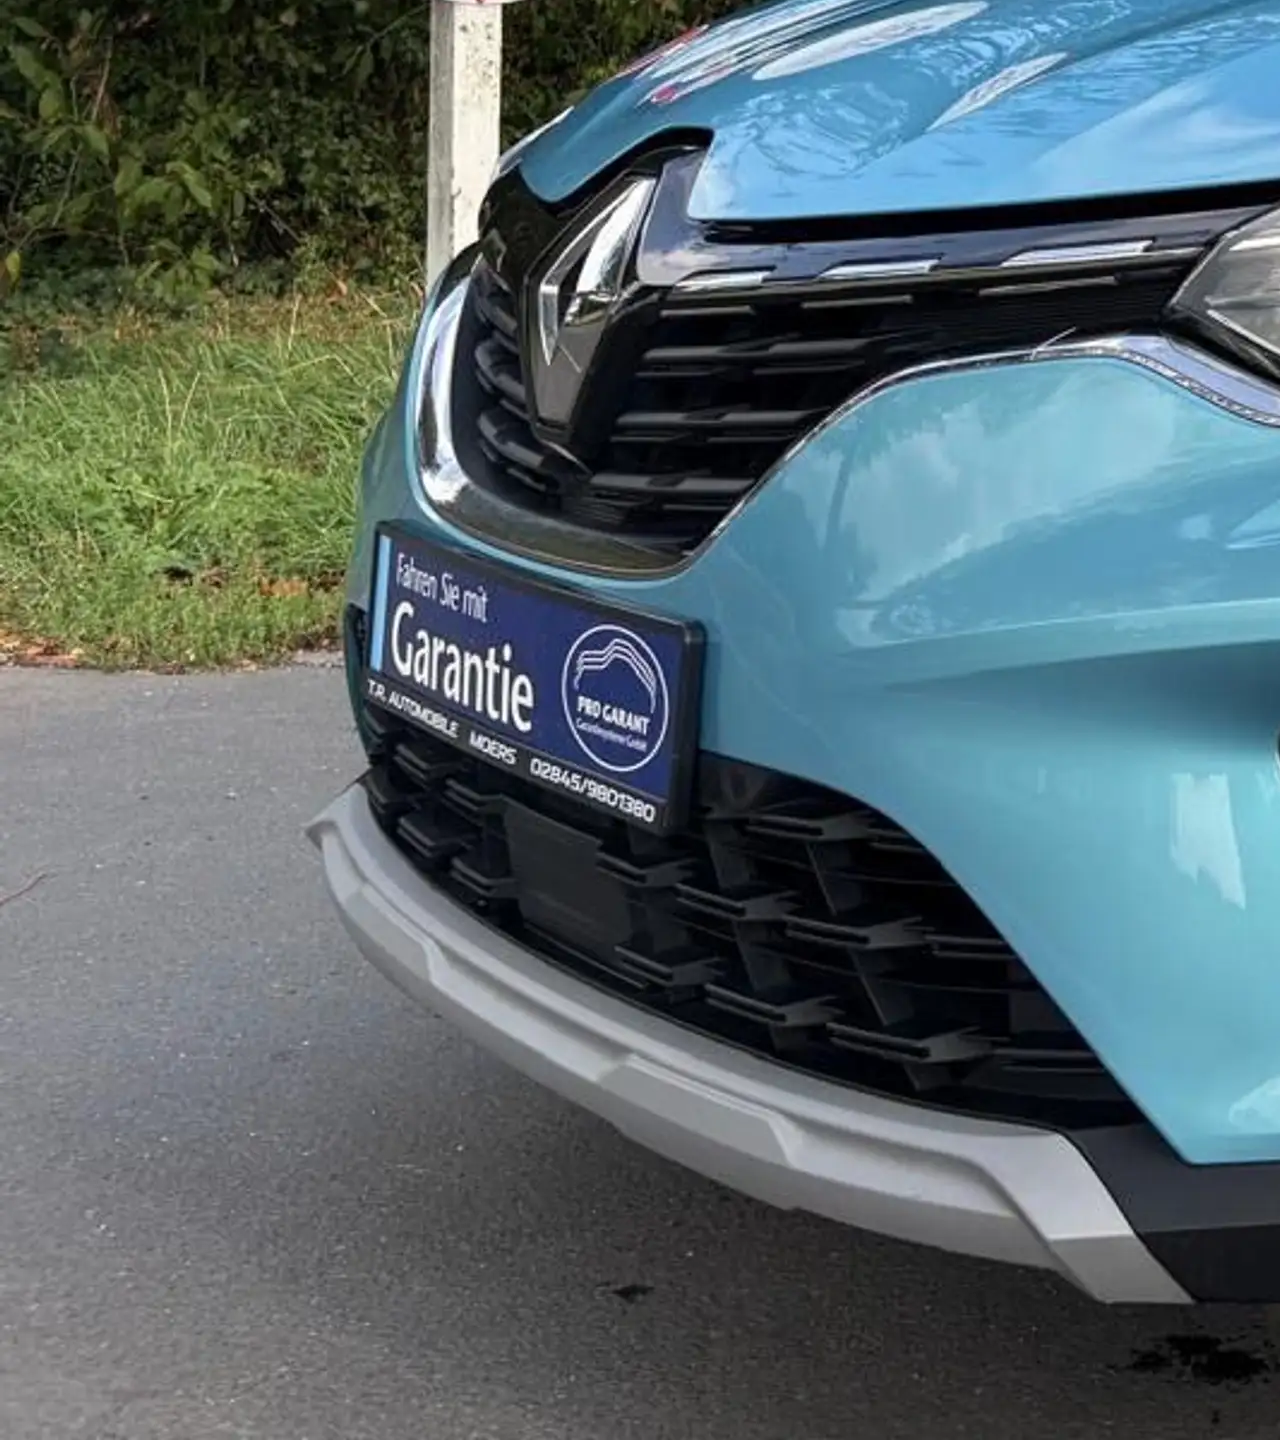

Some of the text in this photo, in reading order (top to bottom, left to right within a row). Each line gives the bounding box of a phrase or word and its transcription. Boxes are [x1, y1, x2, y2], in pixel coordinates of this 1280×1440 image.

[396, 552, 488, 623] Fahren Sie mit
[391, 601, 534, 732] Garantie
[388, 691, 460, 738] AUTOMOBILE
[469, 730, 518, 765] MOERS
[577, 695, 601, 719] PRO
[602, 704, 650, 735] GARANT
